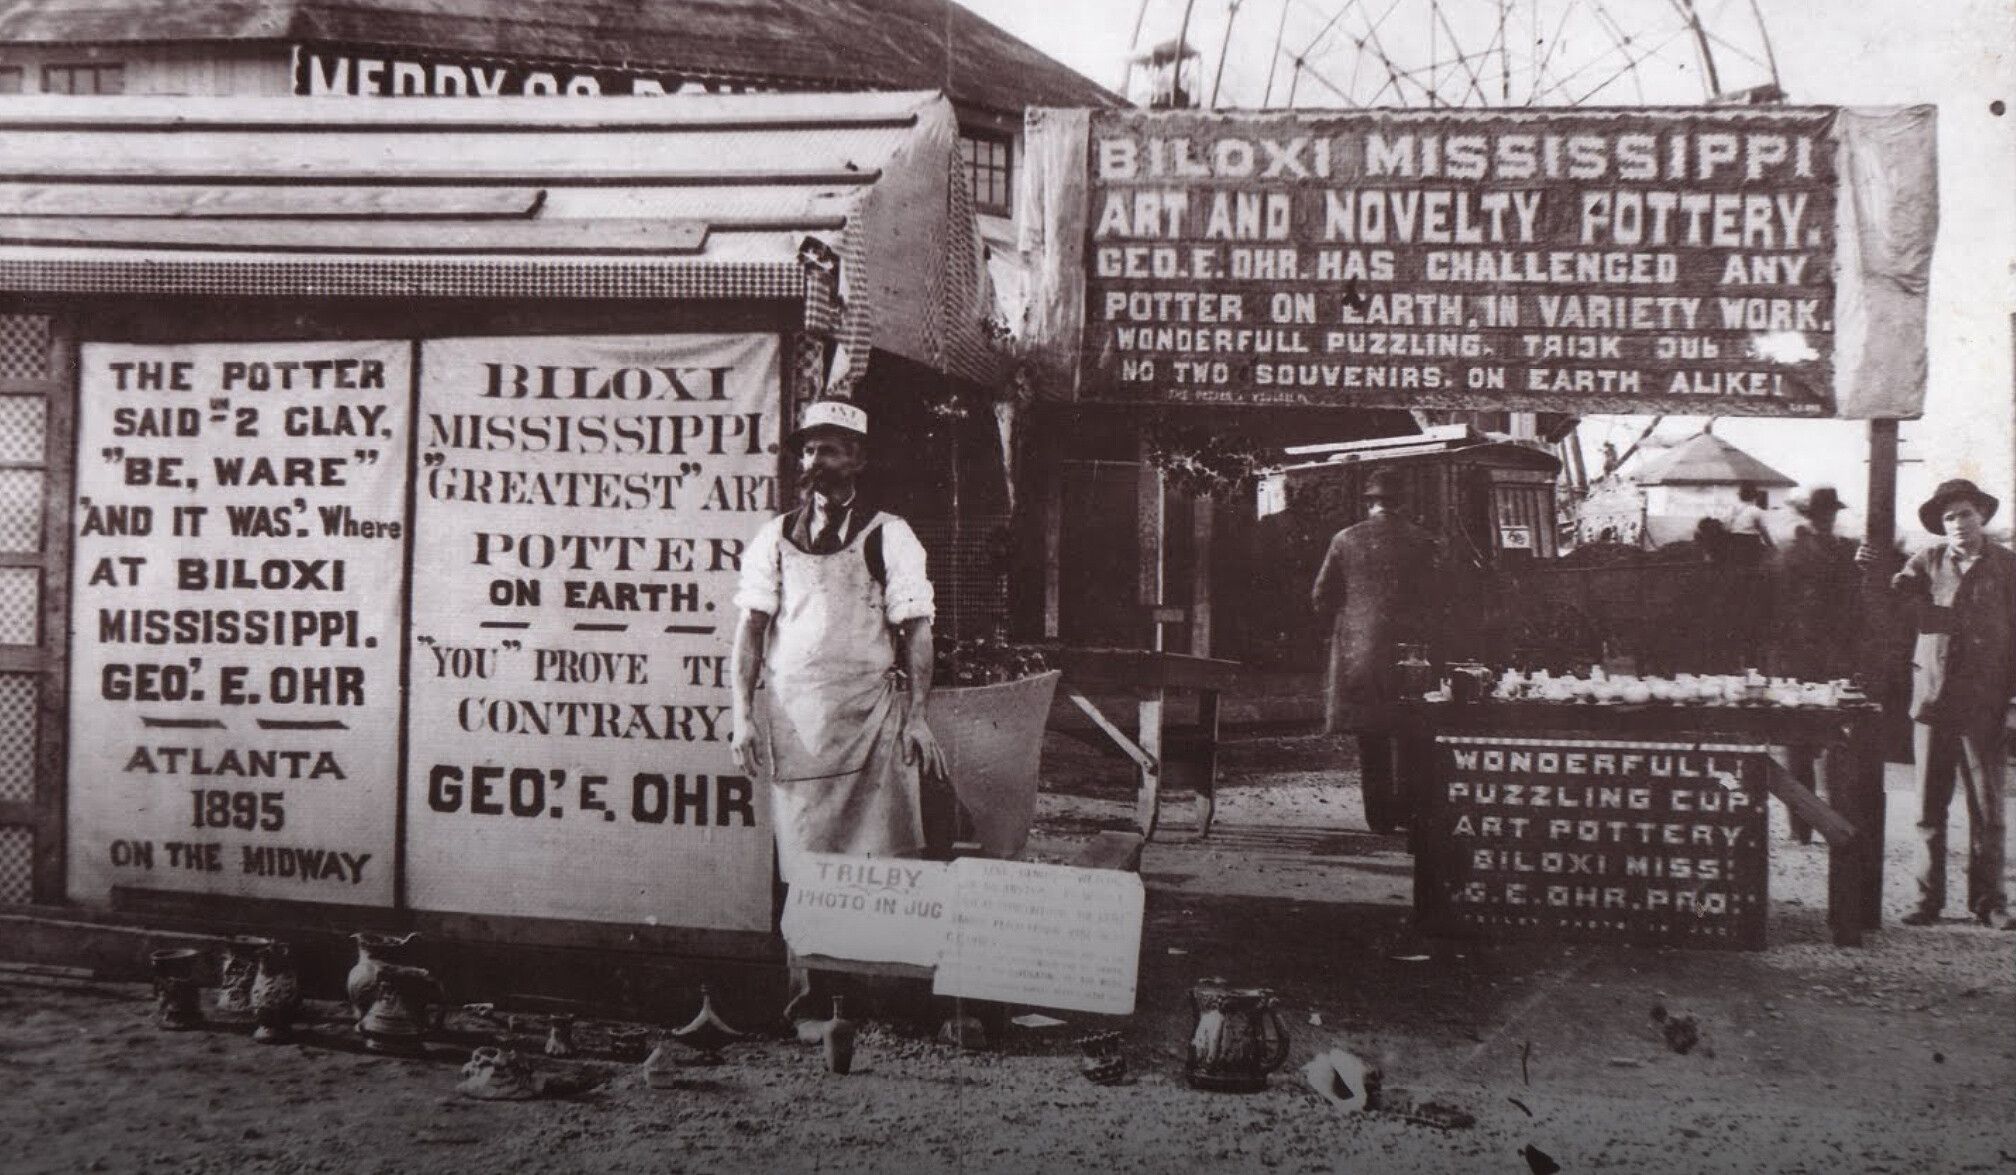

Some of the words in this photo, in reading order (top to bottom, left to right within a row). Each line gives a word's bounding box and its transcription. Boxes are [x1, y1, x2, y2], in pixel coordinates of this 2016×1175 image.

[1099, 137, 1331, 179] BILOXI
[1365, 132, 1814, 181] MISSISSIPPI
[1095, 189, 1188, 240] ART
[1204, 190, 1290, 240] AND
[1325, 189, 1542, 244] NOVELTY
[1426, 250, 1677, 283] CHALLENGED
[1720, 253, 1808, 285] ANY
[1105, 291, 1243, 322] POTTER
[1271, 292, 1316, 324] ON
[1538, 296, 1701, 329] VARIETY
[1720, 297, 1832, 332] WORK.
[1117, 327, 1309, 353] WONDERFULL
[109, 361, 194, 390] THE
[222, 359, 385, 390] POTTER
[477, 362, 735, 402] BILOXI
[1121, 360, 1154, 383] NO
[1173, 362, 1228, 385] TWO
[1467, 366, 1504, 390] ON
[1528, 368, 1640, 394] EARTH
[113, 407, 200, 437] SAID
[235, 407, 259, 437] 2
[284, 405, 392, 440] CLAY,
[428, 412, 779, 456] MISSISSIPPI.
[701, 474, 779, 512] ART
[172, 505, 208, 537] IT
[318, 505, 402, 539] Where
[472, 531, 745, 573] POTTER
[89, 556, 147, 587] AT
[178, 558, 345, 592] BILOXI
[489, 578, 540, 608] ON
[564, 580, 716, 612] EARTH.
[99, 608, 377, 648] MISSISSIPPI.
[533, 649, 649, 685] PROVE
[270, 666, 365, 706] OHR
[458, 696, 734, 743] CONTRARY.
[122, 745, 347, 780] ATLANTA
[191, 789, 285, 832] 1895
[632, 772, 756, 827] OHR
[1449, 782, 1650, 810] PUZZLING
[1453, 814, 1529, 839] ART
[1549, 819, 1756, 848] POTTERY.
[110, 839, 154, 871] ON
[165, 841, 223, 872] THE
[243, 845, 372, 885] MIDWAY
[816, 862, 923, 888] TRILBY
[1473, 849, 1606, 875] BILOXI
[797, 889, 865, 911] PHOTO
[875, 897, 897, 914] IN
[904, 900, 943, 919] JUG
